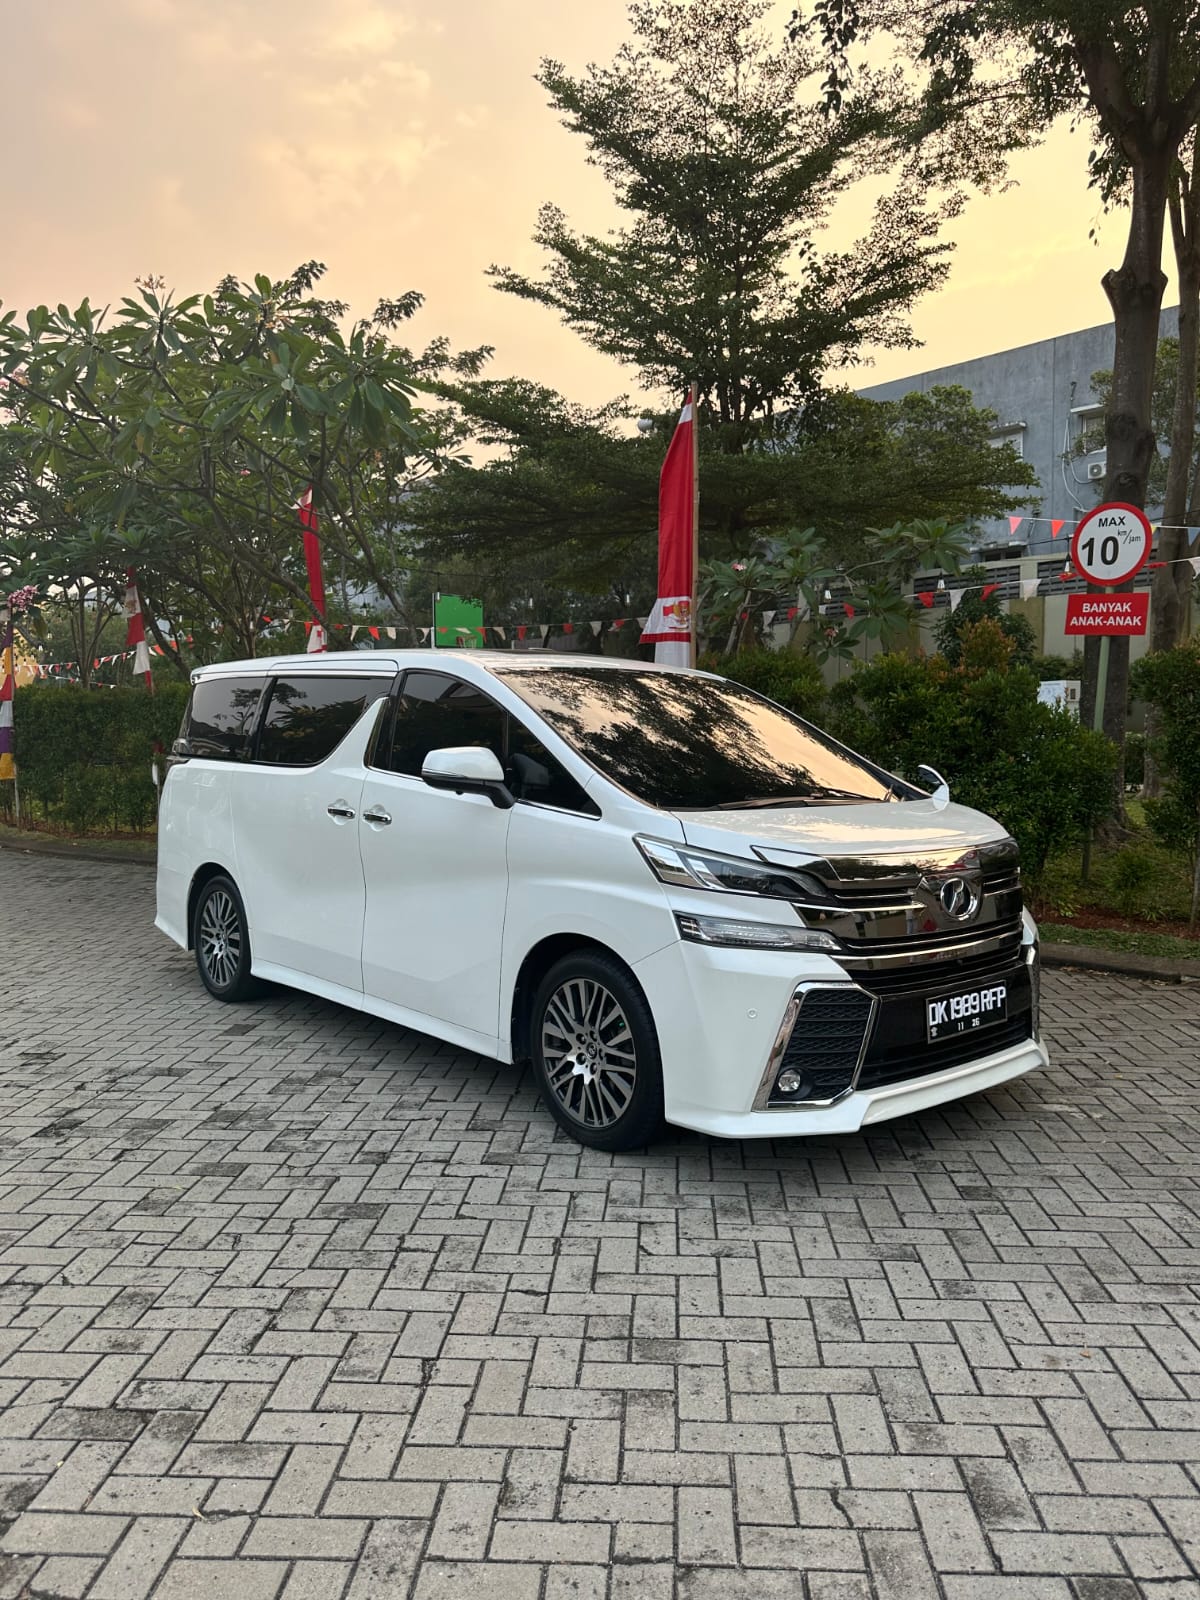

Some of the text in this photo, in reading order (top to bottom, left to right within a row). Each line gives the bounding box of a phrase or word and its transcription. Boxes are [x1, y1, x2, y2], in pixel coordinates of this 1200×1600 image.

[1098, 516, 1126, 528] MAX
[1081, 536, 1119, 566] 10
[1082, 602, 1132, 613] BANYAK
[1070, 616, 1142, 626] ANAK-ANAK
[929, 986, 1006, 1026] DK 1989 RFP
